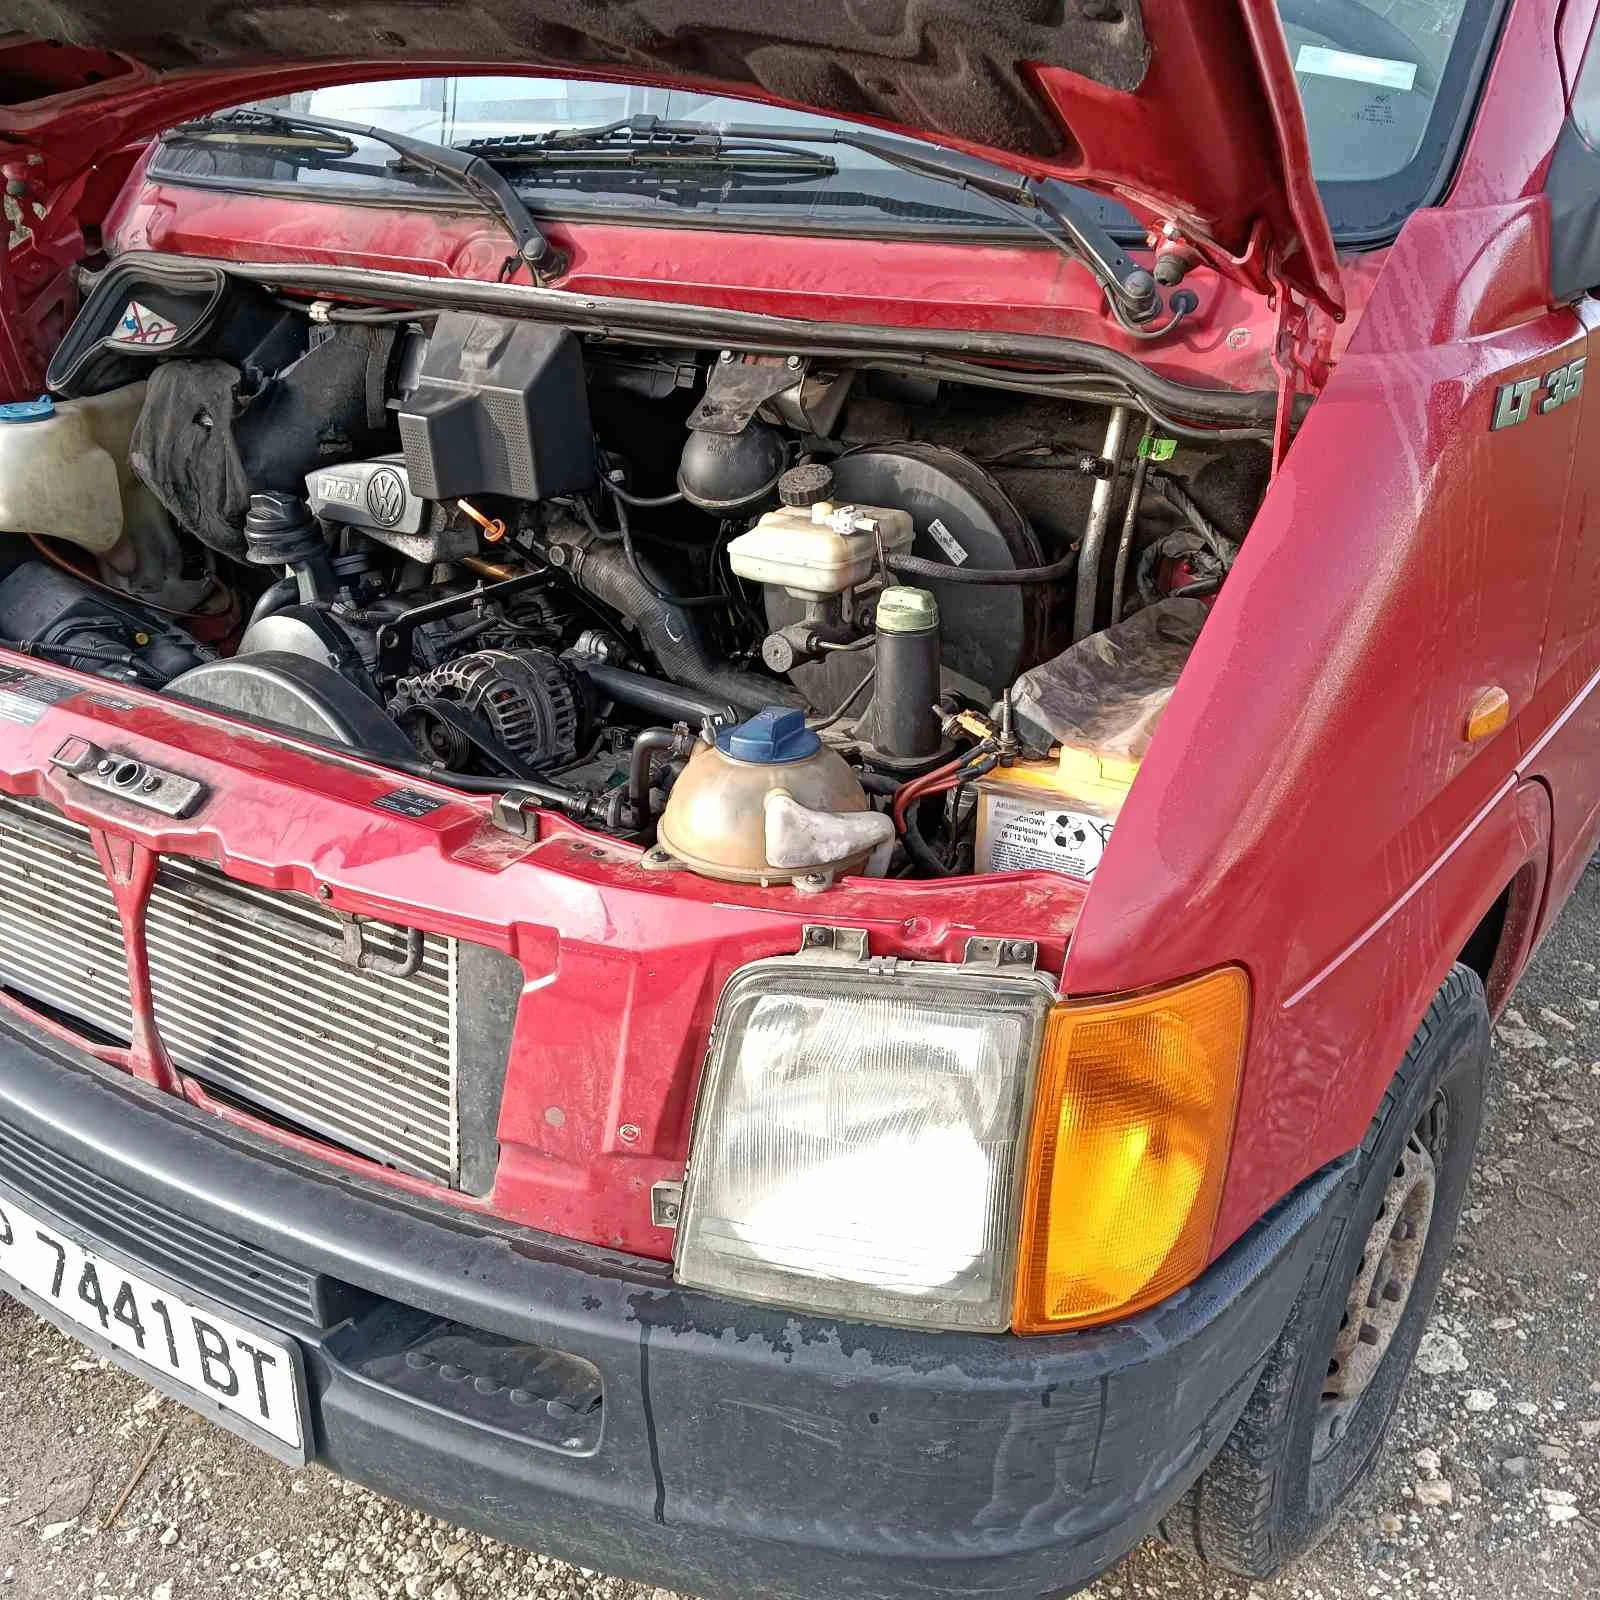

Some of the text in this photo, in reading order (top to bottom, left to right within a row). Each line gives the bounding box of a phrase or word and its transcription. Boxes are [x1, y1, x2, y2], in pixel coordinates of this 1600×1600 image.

[1489, 356, 1587, 432] LT 35
[37, 1229, 276, 1418] 7441 BT
